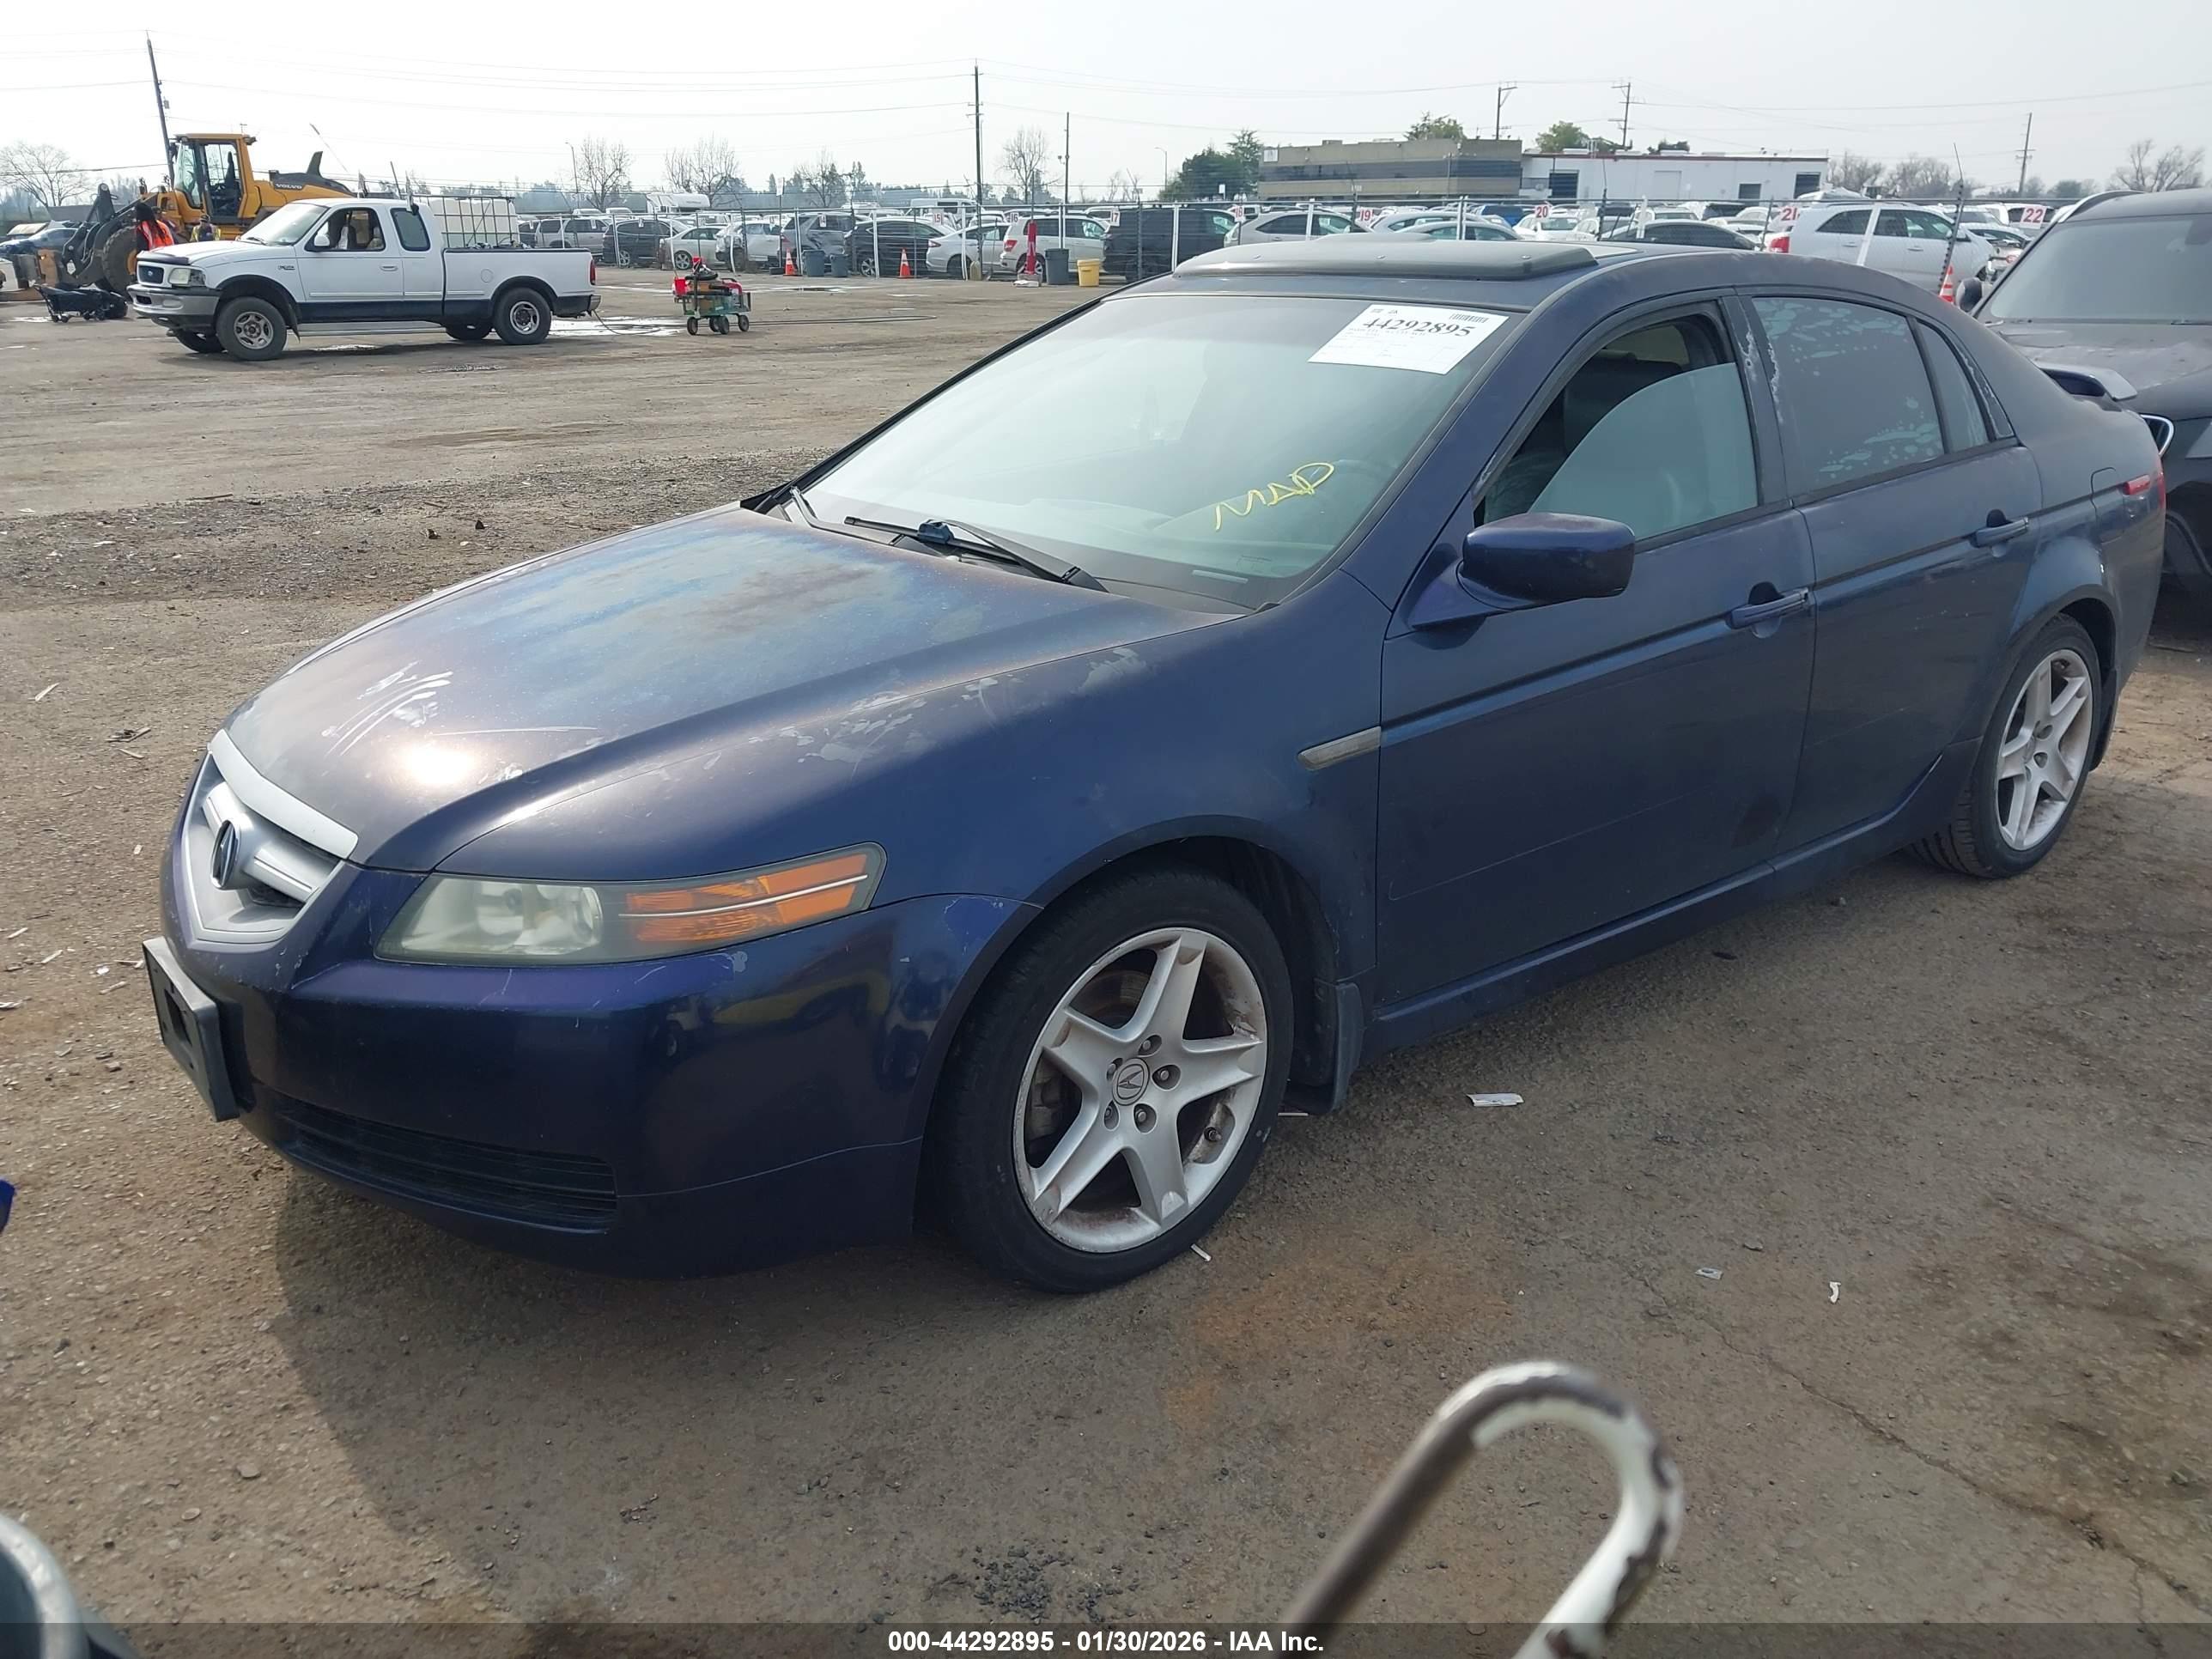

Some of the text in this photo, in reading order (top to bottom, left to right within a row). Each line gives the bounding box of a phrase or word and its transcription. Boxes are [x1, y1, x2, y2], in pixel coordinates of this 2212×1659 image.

[1361, 210, 1370, 221] 19
[1535, 205, 1548, 218] 20
[1781, 207, 1797, 222] 21
[2022, 207, 2044, 223] 22
[1363, 317, 1476, 337] 44292895
